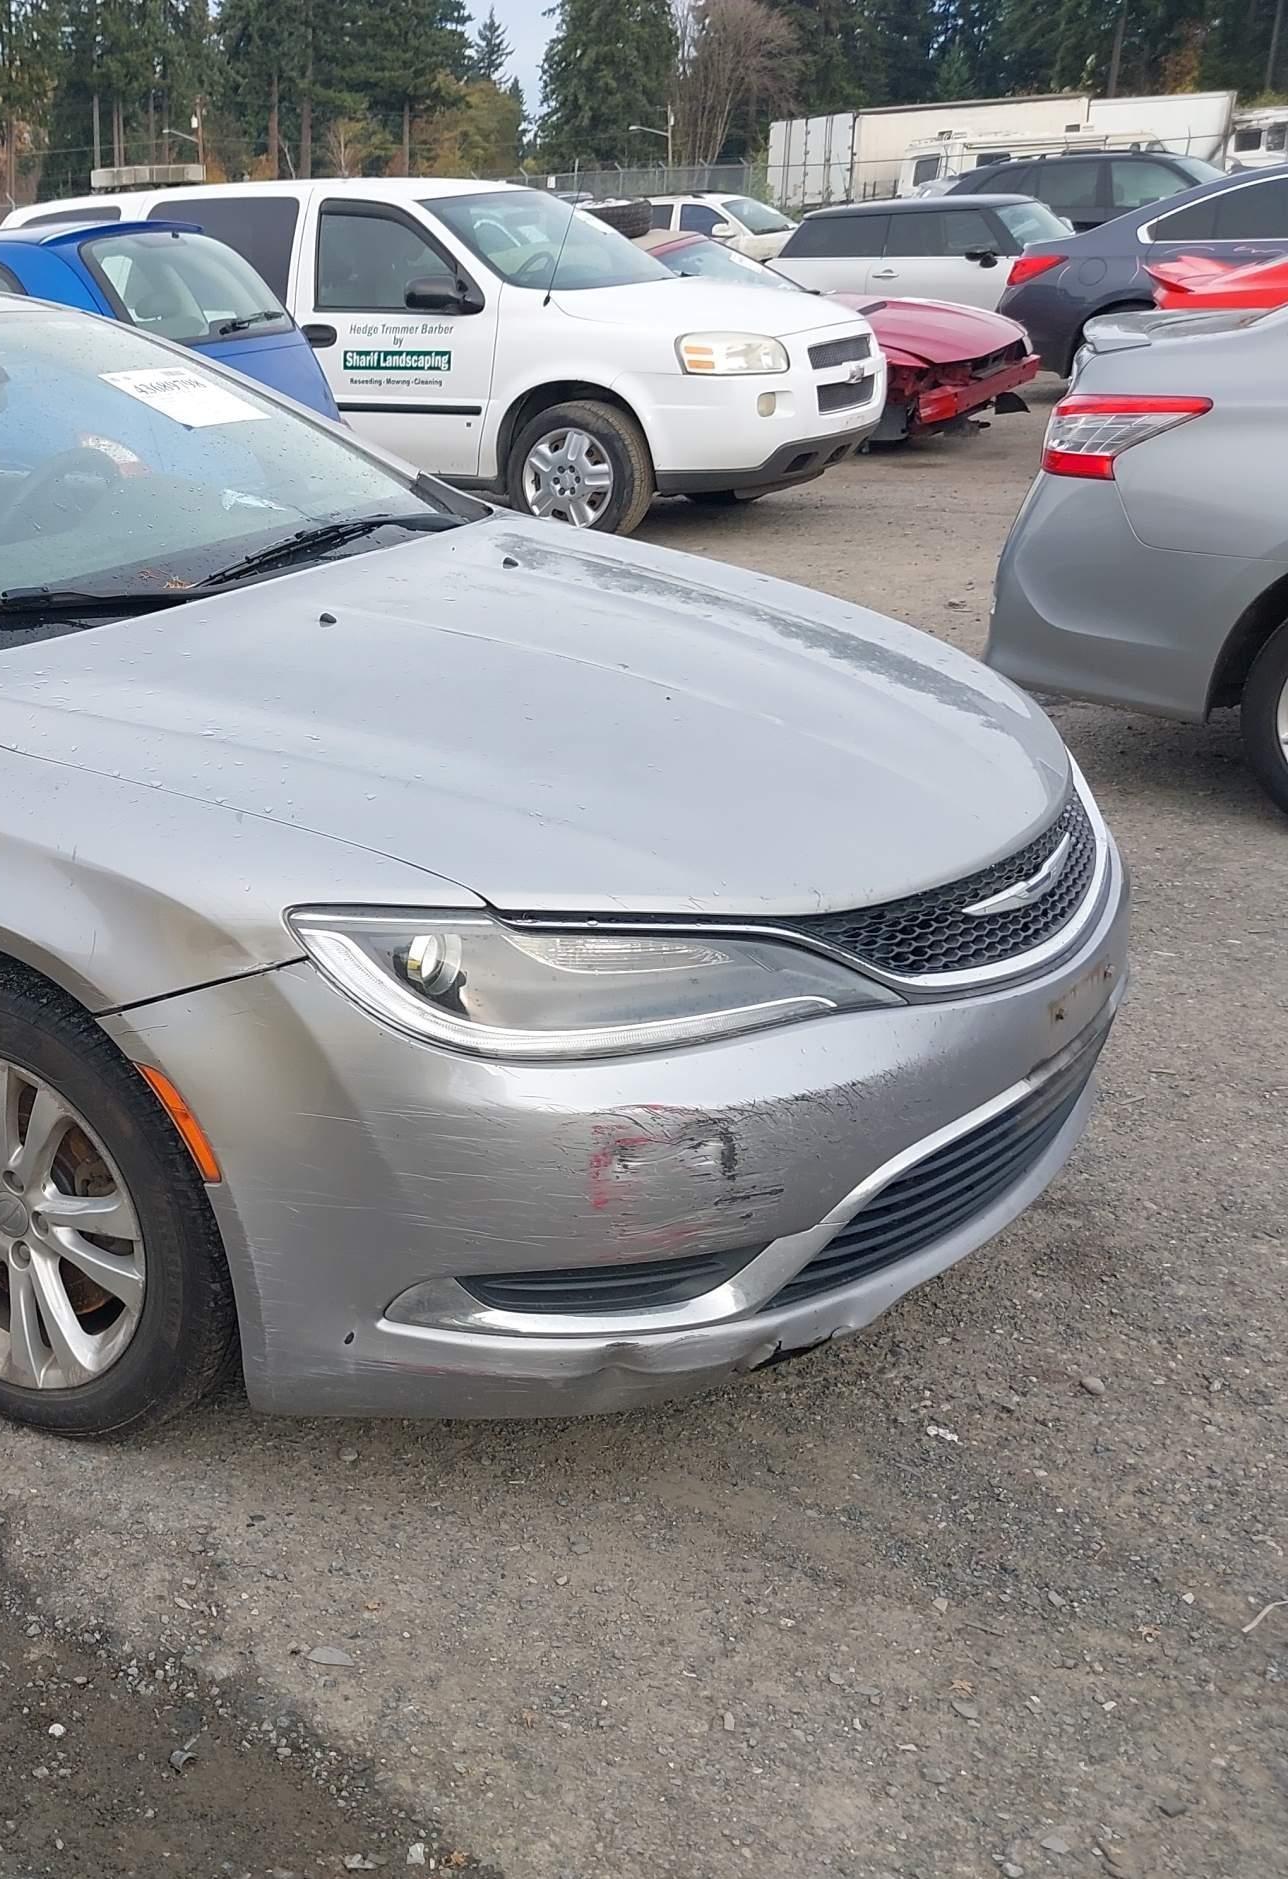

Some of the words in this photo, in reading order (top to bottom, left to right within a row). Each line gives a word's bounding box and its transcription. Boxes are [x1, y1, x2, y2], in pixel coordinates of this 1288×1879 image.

[349, 324, 378, 337] Hedge
[381, 324, 419, 335] Trimmer
[421, 323, 454, 335] Barber
[393, 336, 404, 348] by
[345, 352, 378, 368] Sharif
[380, 352, 449, 371] Landscaping
[386, 377, 411, 387] Mowing
[414, 377, 443, 387] Cleaning
